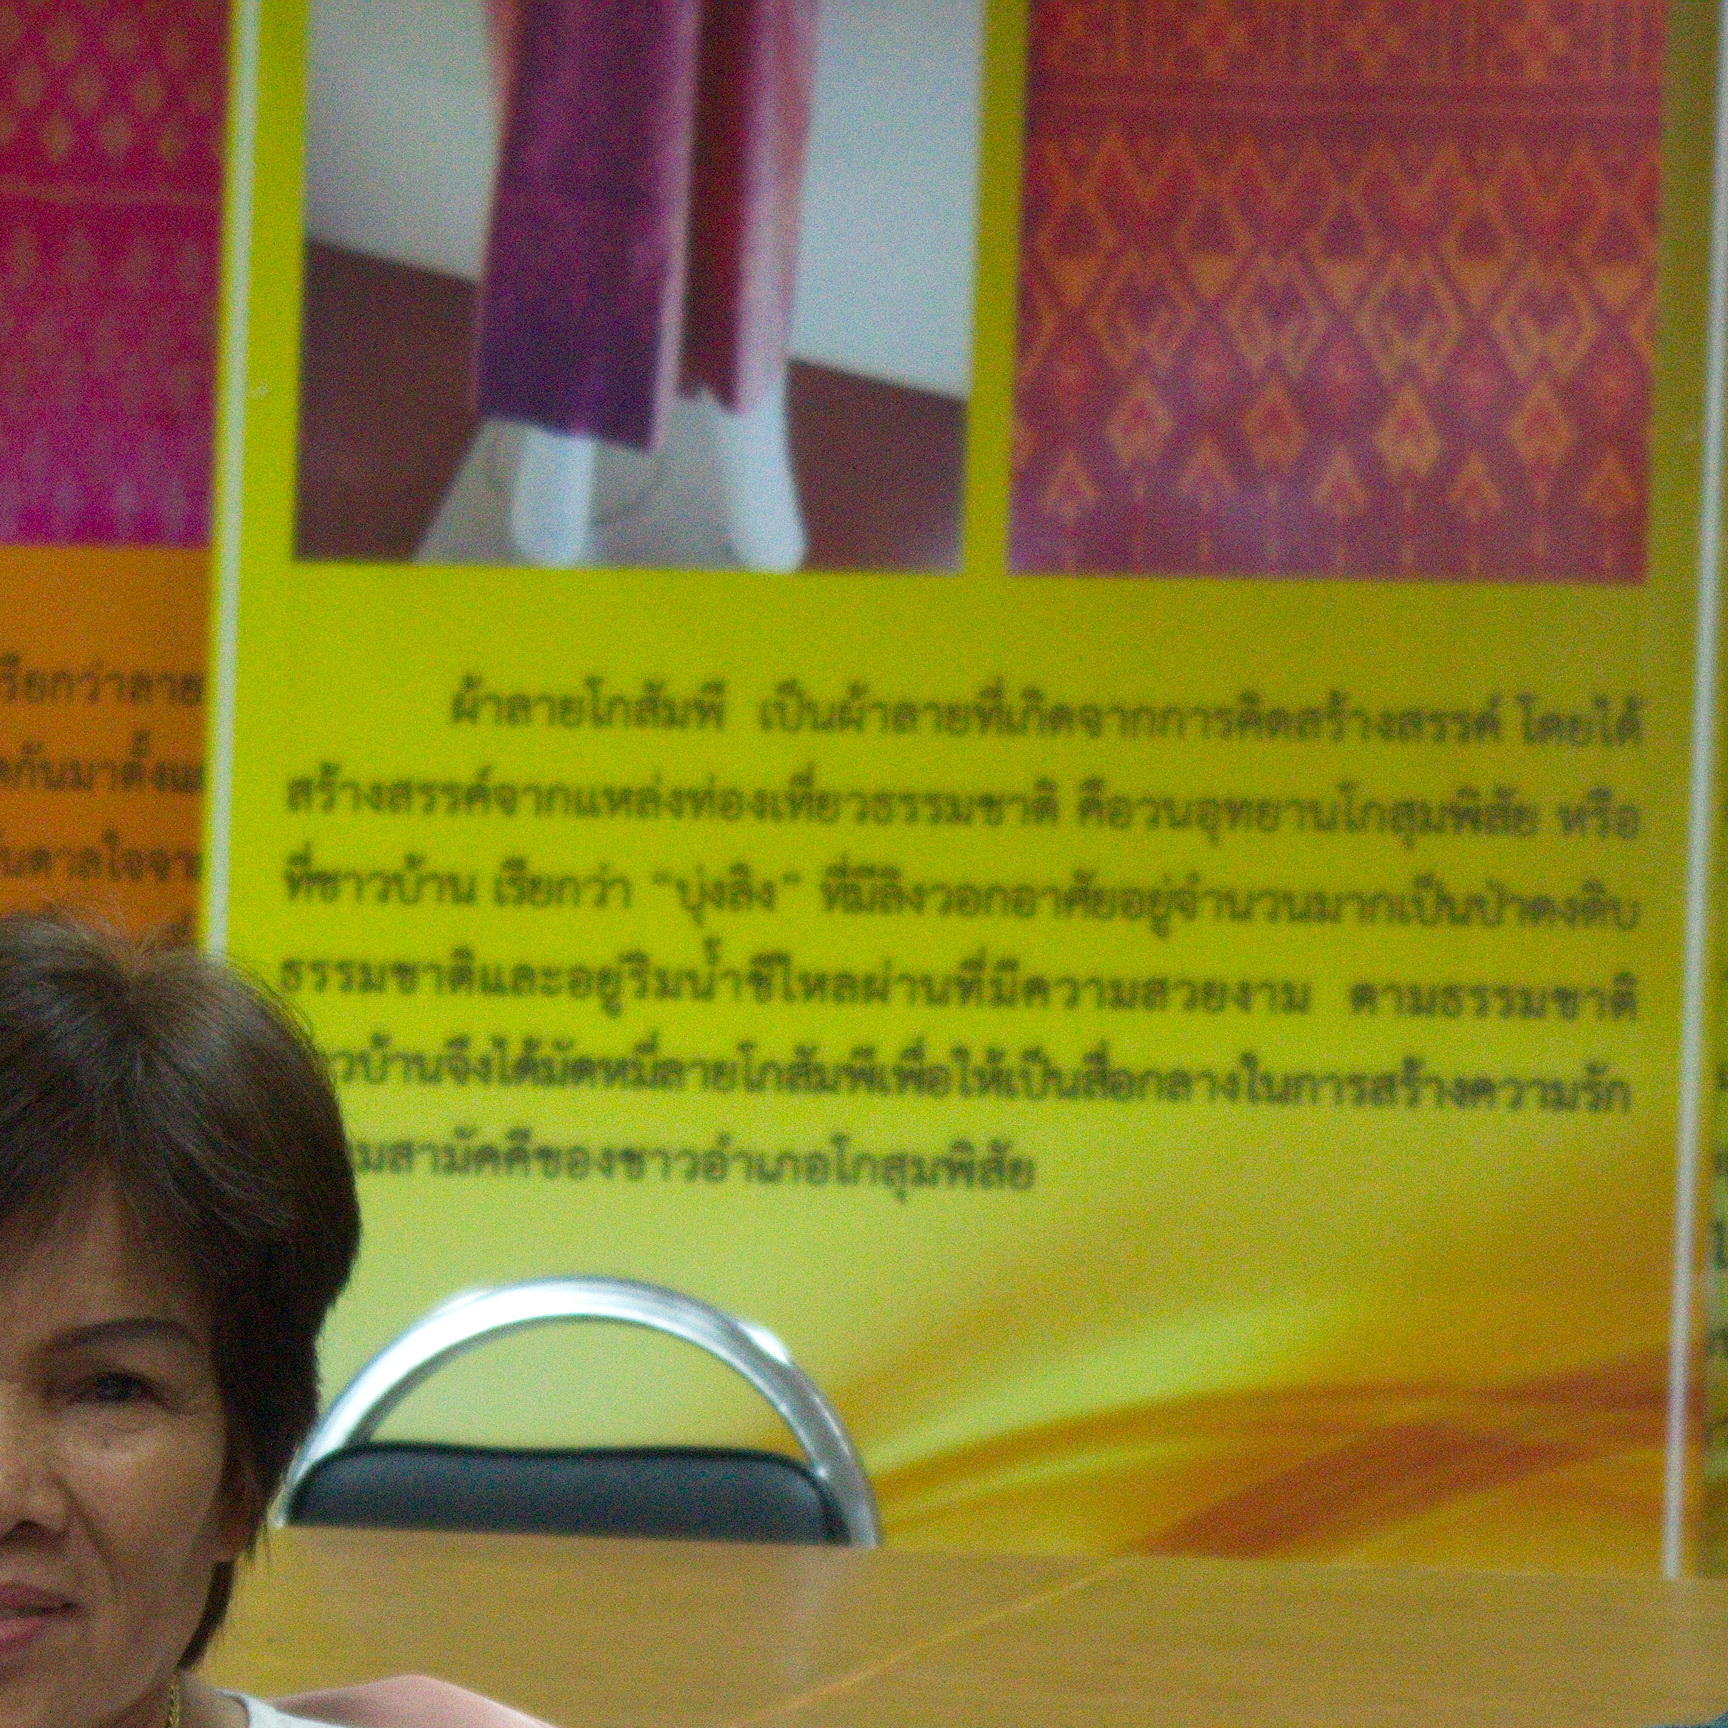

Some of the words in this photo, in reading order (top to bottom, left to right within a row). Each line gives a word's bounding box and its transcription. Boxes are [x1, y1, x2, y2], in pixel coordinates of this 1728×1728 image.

[448, 674, 728, 731] ผ้าลายโกสัมพี
[1349, 969, 1639, 1022] ตามธรรมชาติ
[330, 1030, 1634, 1115] วบ้านจึงได้มัดหมี่ลายโกสัมพีเพื่อให้เป็นสื่อกลางในการสร้างความรัก
[350, 1126, 1037, 1200] มสามัคคีของชาวอำเภอโกสุมพิสัย
